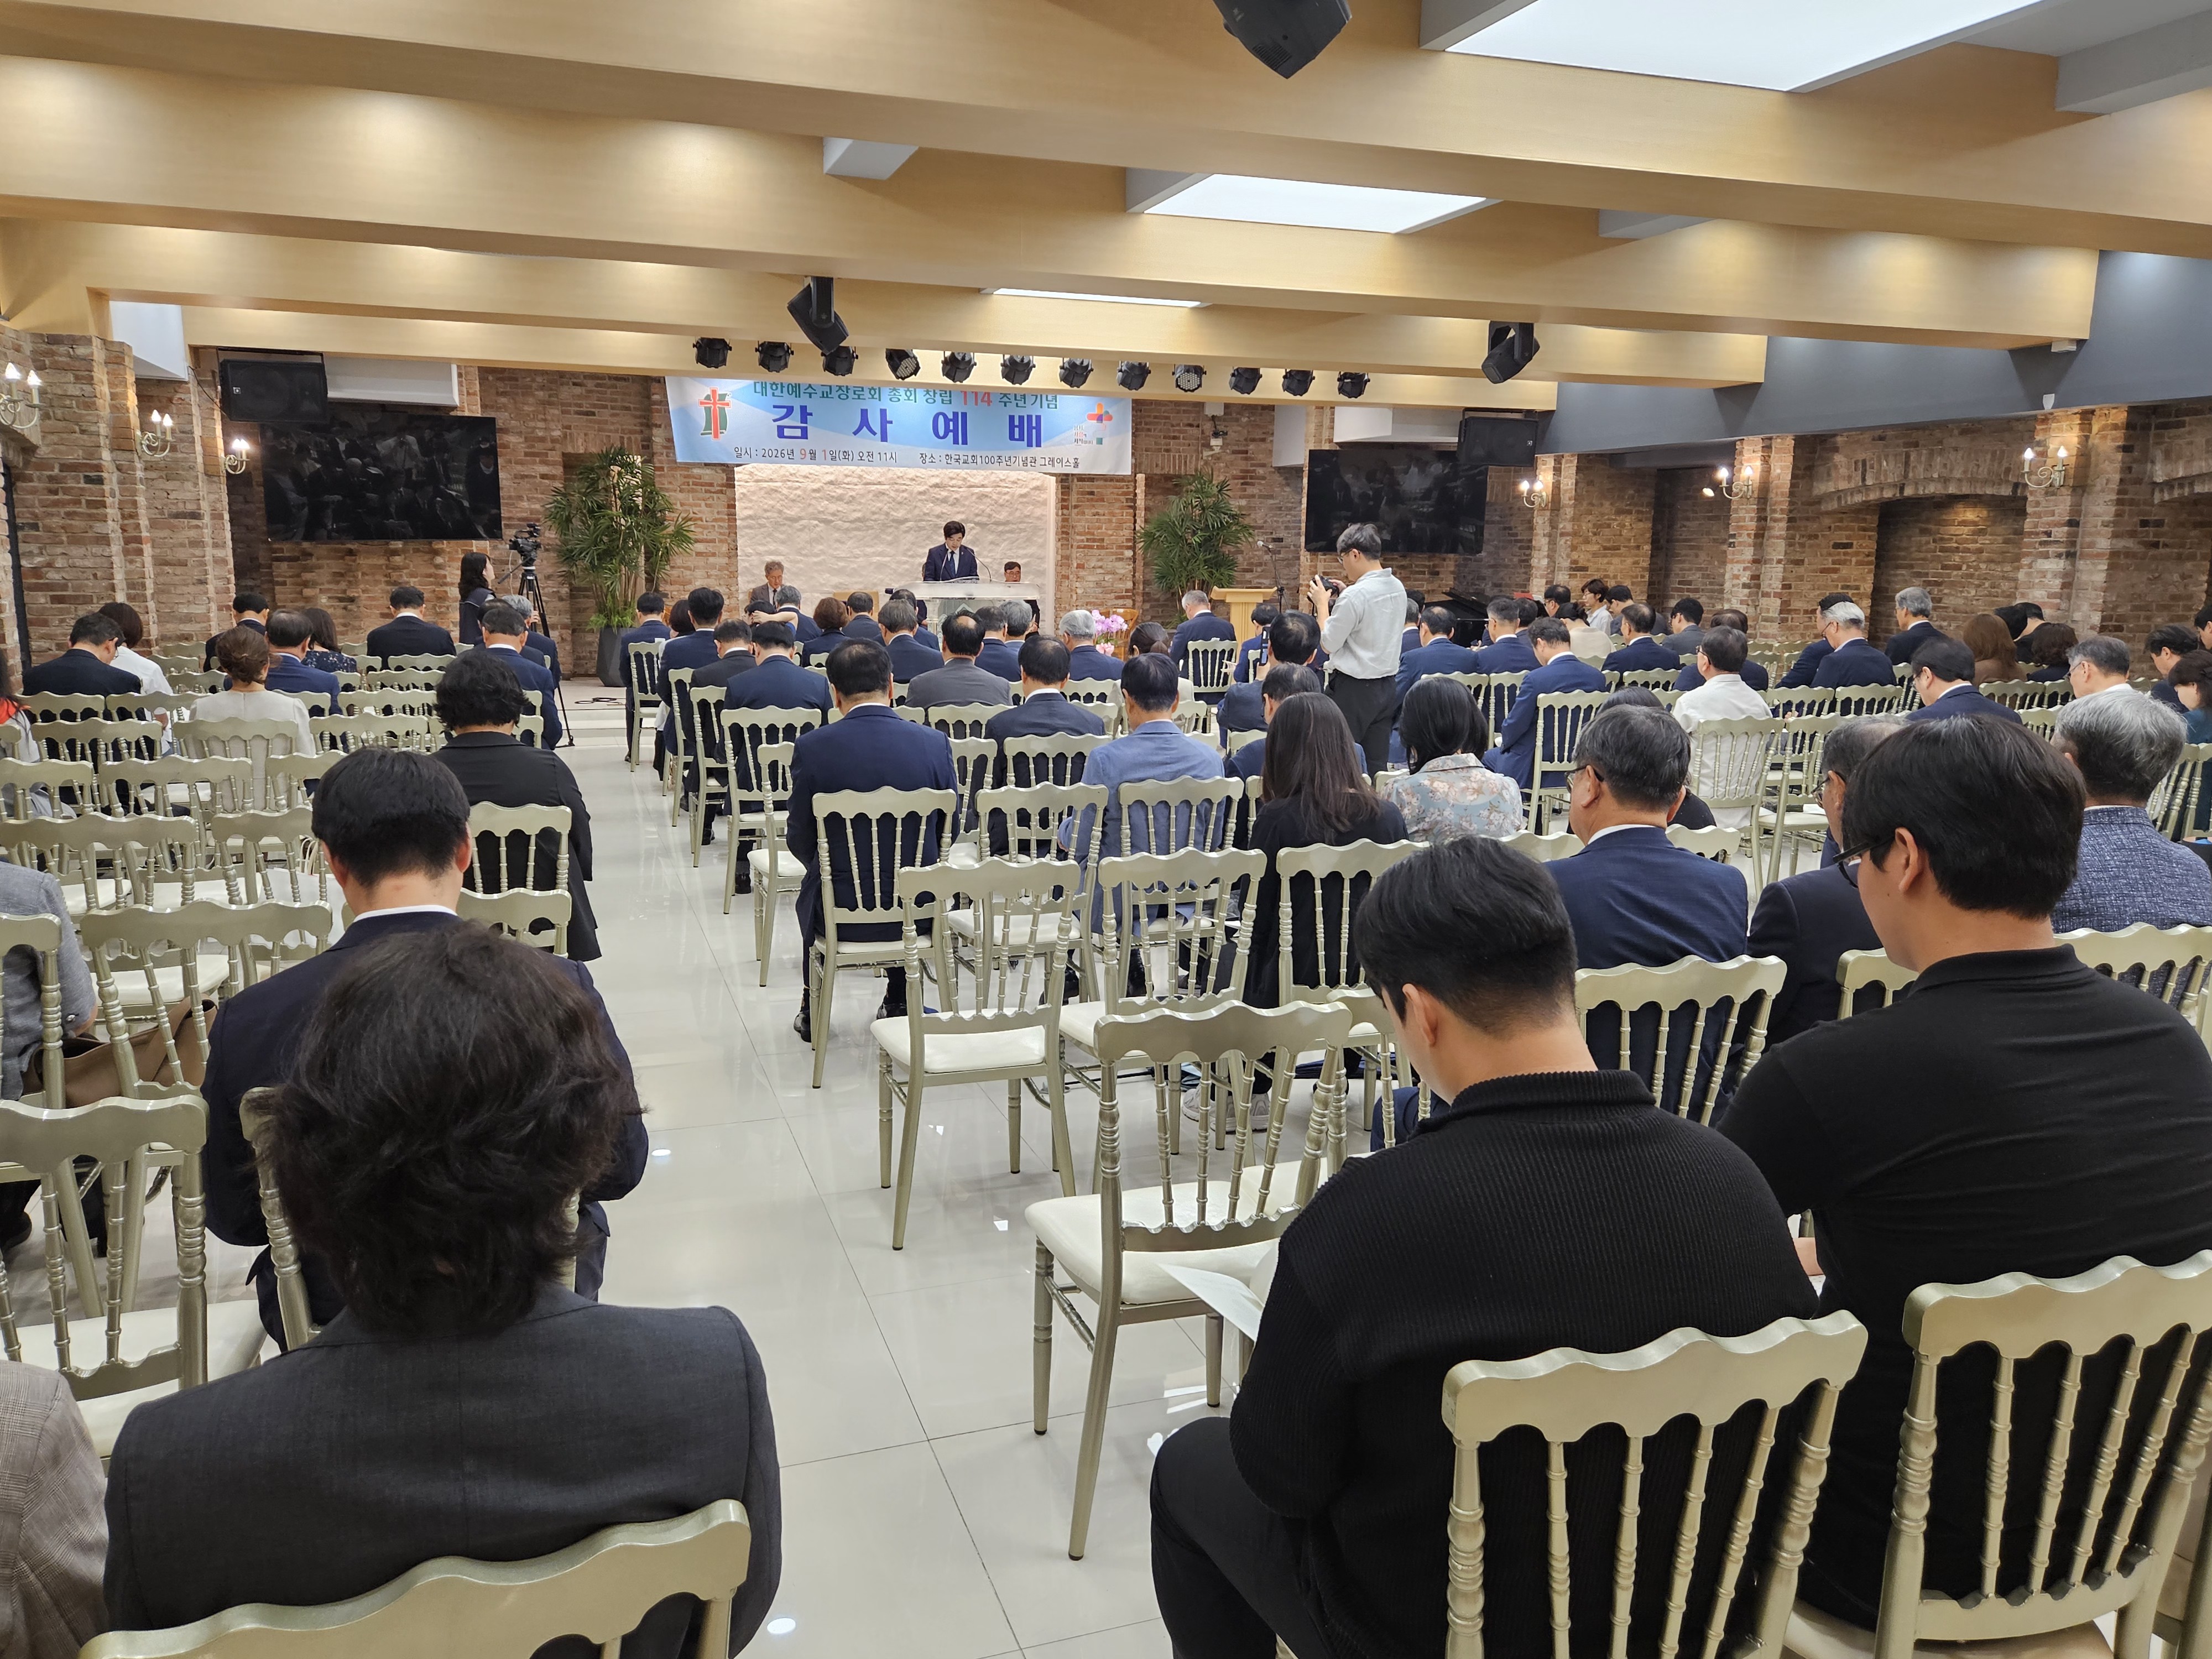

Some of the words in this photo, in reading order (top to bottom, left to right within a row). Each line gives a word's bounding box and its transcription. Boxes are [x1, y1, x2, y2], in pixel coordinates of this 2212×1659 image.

[753, 381, 881, 401] 대한예수교장로회
[888, 387, 917, 403] 총회
[923, 389, 952, 404] 창립
[960, 390, 993, 406] 114
[734, 446, 752, 458] 일시
[761, 448, 795, 460] 2026년
[857, 450, 874, 463] 오전
[877, 452, 898, 463] 11시
[920, 453, 936, 465] 장소
[945, 453, 1037, 468] 한국교회100주년기념관
[1040, 456, 1081, 469] 그레이스홀
